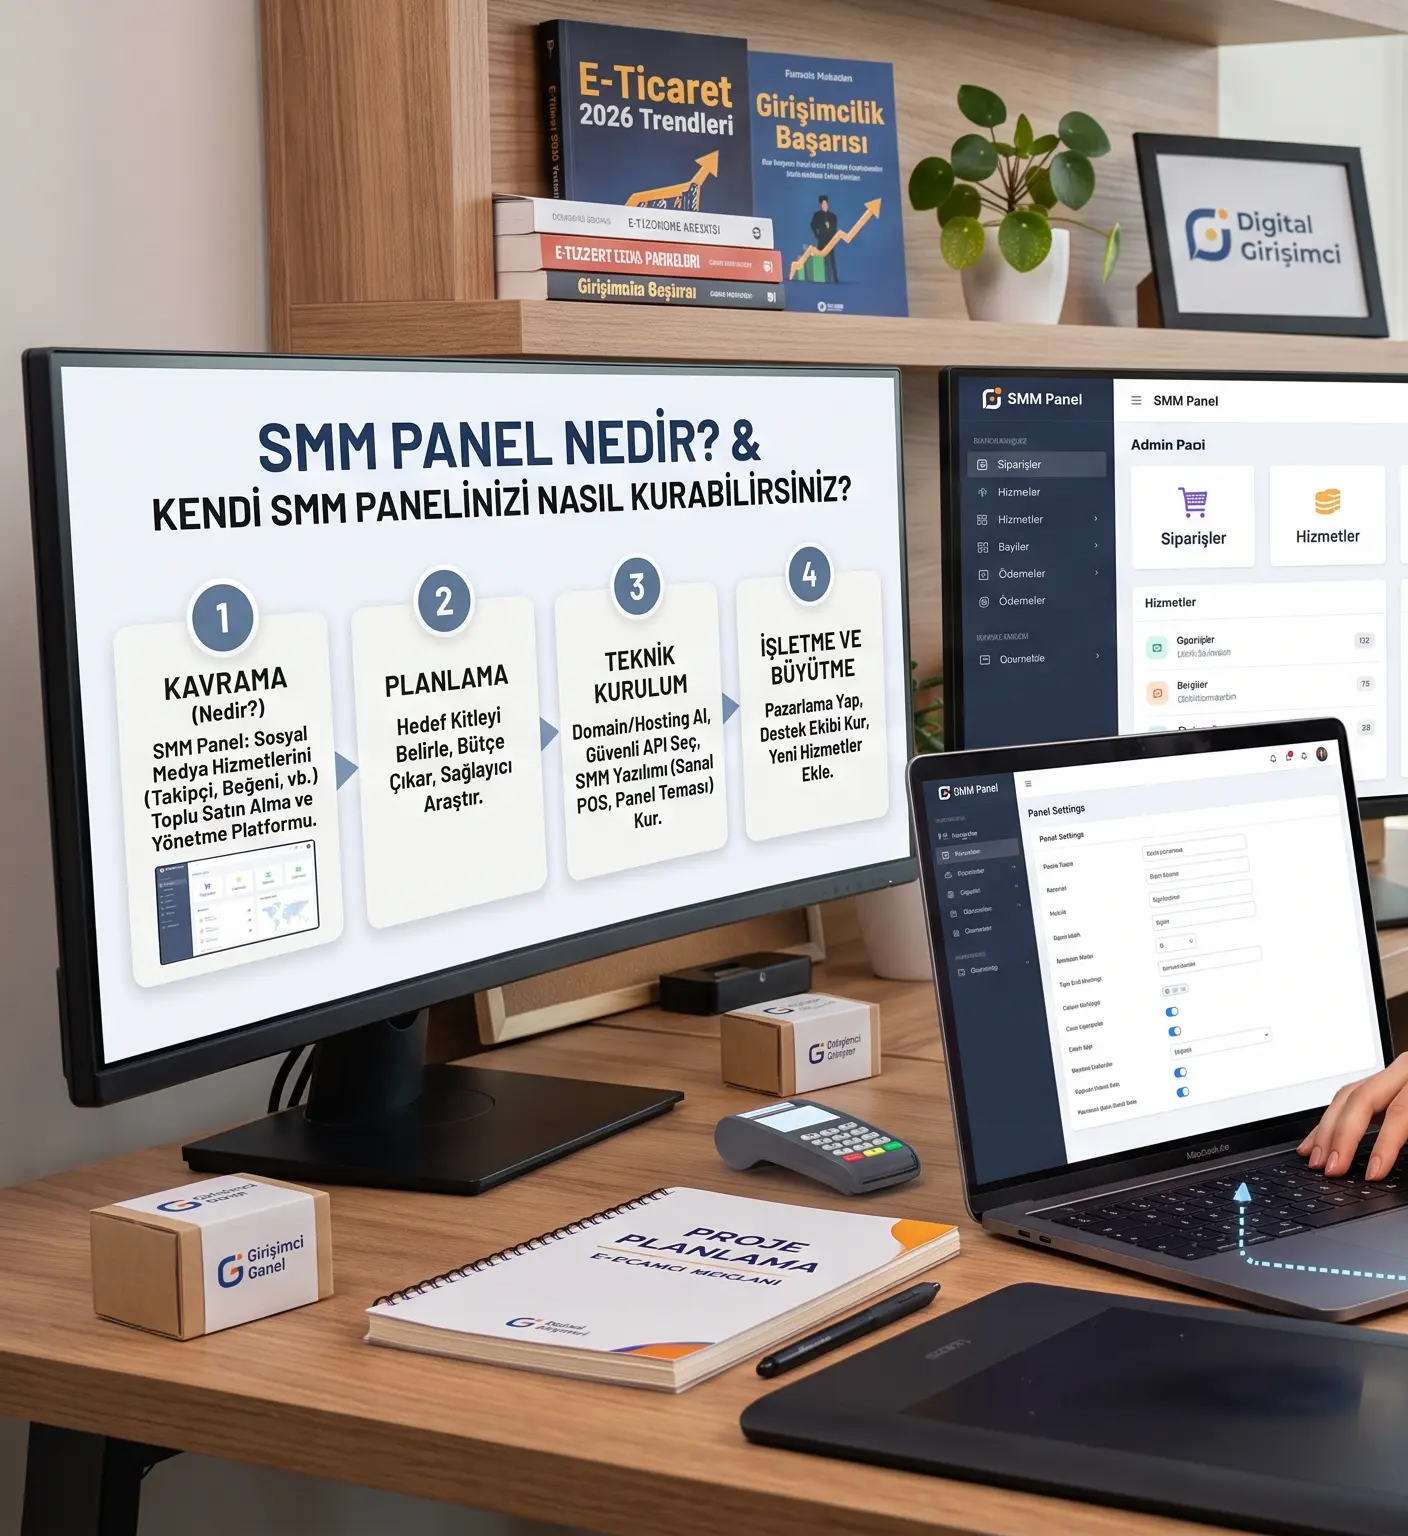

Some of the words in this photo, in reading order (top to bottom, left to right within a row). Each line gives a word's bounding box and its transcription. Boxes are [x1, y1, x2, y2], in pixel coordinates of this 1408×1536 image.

[579, 61, 733, 108] E-Ticaret
[579, 103, 634, 128] 2026
[639, 108, 734, 135] Trendleri
[756, 92, 885, 127] Girişimcilik
[776, 125, 868, 157] Başarısı
[1236, 212, 1313, 237] Digital
[1241, 242, 1342, 267] Girişimci
[1007, 392, 1042, 406] SMM
[1045, 393, 1083, 406] Panel
[1153, 395, 1184, 407] SMM
[1186, 395, 1219, 407] Panel
[259, 422, 377, 472] SMM
[392, 421, 553, 467] PANEL
[565, 408, 719, 465] NEDİR?
[731, 419, 762, 462] &
[1131, 439, 1173, 451] Admin
[997, 459, 1042, 471] Siparişler
[152, 486, 262, 531] KENDİ
[271, 493, 347, 526] SMM
[356, 478, 529, 523] PANELİNİZİ
[538, 483, 624, 515] NASIL
[631, 468, 852, 511] KURABİLİRSİNİZ?
[998, 487, 1041, 497] Hizmeler
[998, 514, 1043, 525] Hizmetler
[998, 542, 1029, 553] Bayiler
[1160, 531, 1227, 548] Siparişler
[1295, 529, 1361, 544] Hizmetler
[629, 572, 645, 601] 3
[802, 561, 817, 587] 4
[435, 586, 454, 617] 2
[1145, 597, 1196, 609] Hizmetler
[216, 602, 229, 633] 1
[605, 641, 675, 672] TEKNİK
[761, 631, 835, 660] İŞLETME
[839, 629, 862, 648] VE
[164, 666, 288, 700] KAVRAMA
[385, 664, 509, 698] PLANLAMA
[771, 656, 855, 685] BÜYÜTME
[594, 674, 688, 704] KURULUM
[192, 698, 265, 726] (Nedir?)
[765, 698, 833, 718] Pazarlama
[836, 694, 864, 711] Yap,
[397, 713, 447, 736] Hedef
[451, 706, 501, 730] Kitleyi
[572, 711, 690, 741] Domain/Hosting
[761, 722, 807, 742] Destek
[809, 717, 841, 736] Ekibi
[844, 715, 870, 731] Kur,
[153, 740, 192, 759] SMM
[197, 734, 249, 754] Panel:
[254, 725, 308, 749] Sosyal
[396, 740, 453, 763] Belirle,
[458, 735, 505, 756] Bütçe
[586, 741, 640, 763] Güvenli
[643, 737, 668, 756] API
[671, 735, 701, 751] Seç,
[769, 748, 797, 764] Yeni
[801, 739, 863, 760] Hizmetler
[153, 764, 209, 783] Medya
[212, 747, 312, 775] Hizmetlerini
[390, 771, 436, 795] Çıkar,
[441, 760, 513, 785] Sağlayıcı
[575, 770, 610, 789] SMM
[613, 764, 669, 785] Yazılımı
[671, 754, 714, 777] (Sanal
[802, 764, 834, 782] Ekle.
[144, 782, 218, 809] (Takipçi,
[222, 772, 284, 797] Beğeni,
[288, 767, 318, 786] vb.)
[577, 796, 612, 814] POS,
[616, 787, 656, 808] Panel
[659, 776, 715, 803] Teması)
[976, 783, 999, 794] Panel
[152, 808, 198, 830] Toplu
[202, 802, 246, 822] Satın
[250, 797, 291, 815] Alma
[294, 794, 313, 807] ve
[424, 792, 484, 813] Araştır.
[1028, 807, 1050, 817] Panel
[1052, 805, 1085, 815] Settings
[152, 827, 228, 852] Yönetme
[231, 816, 317, 840] Platformu.
[634, 812, 663, 829] Kur.
[248, 1234, 304, 1262] Girişimci
[614, 1233, 819, 1274] PLANLAMA
[682, 1227, 811, 1253] PROJE
[248, 1258, 286, 1279] Ganel
